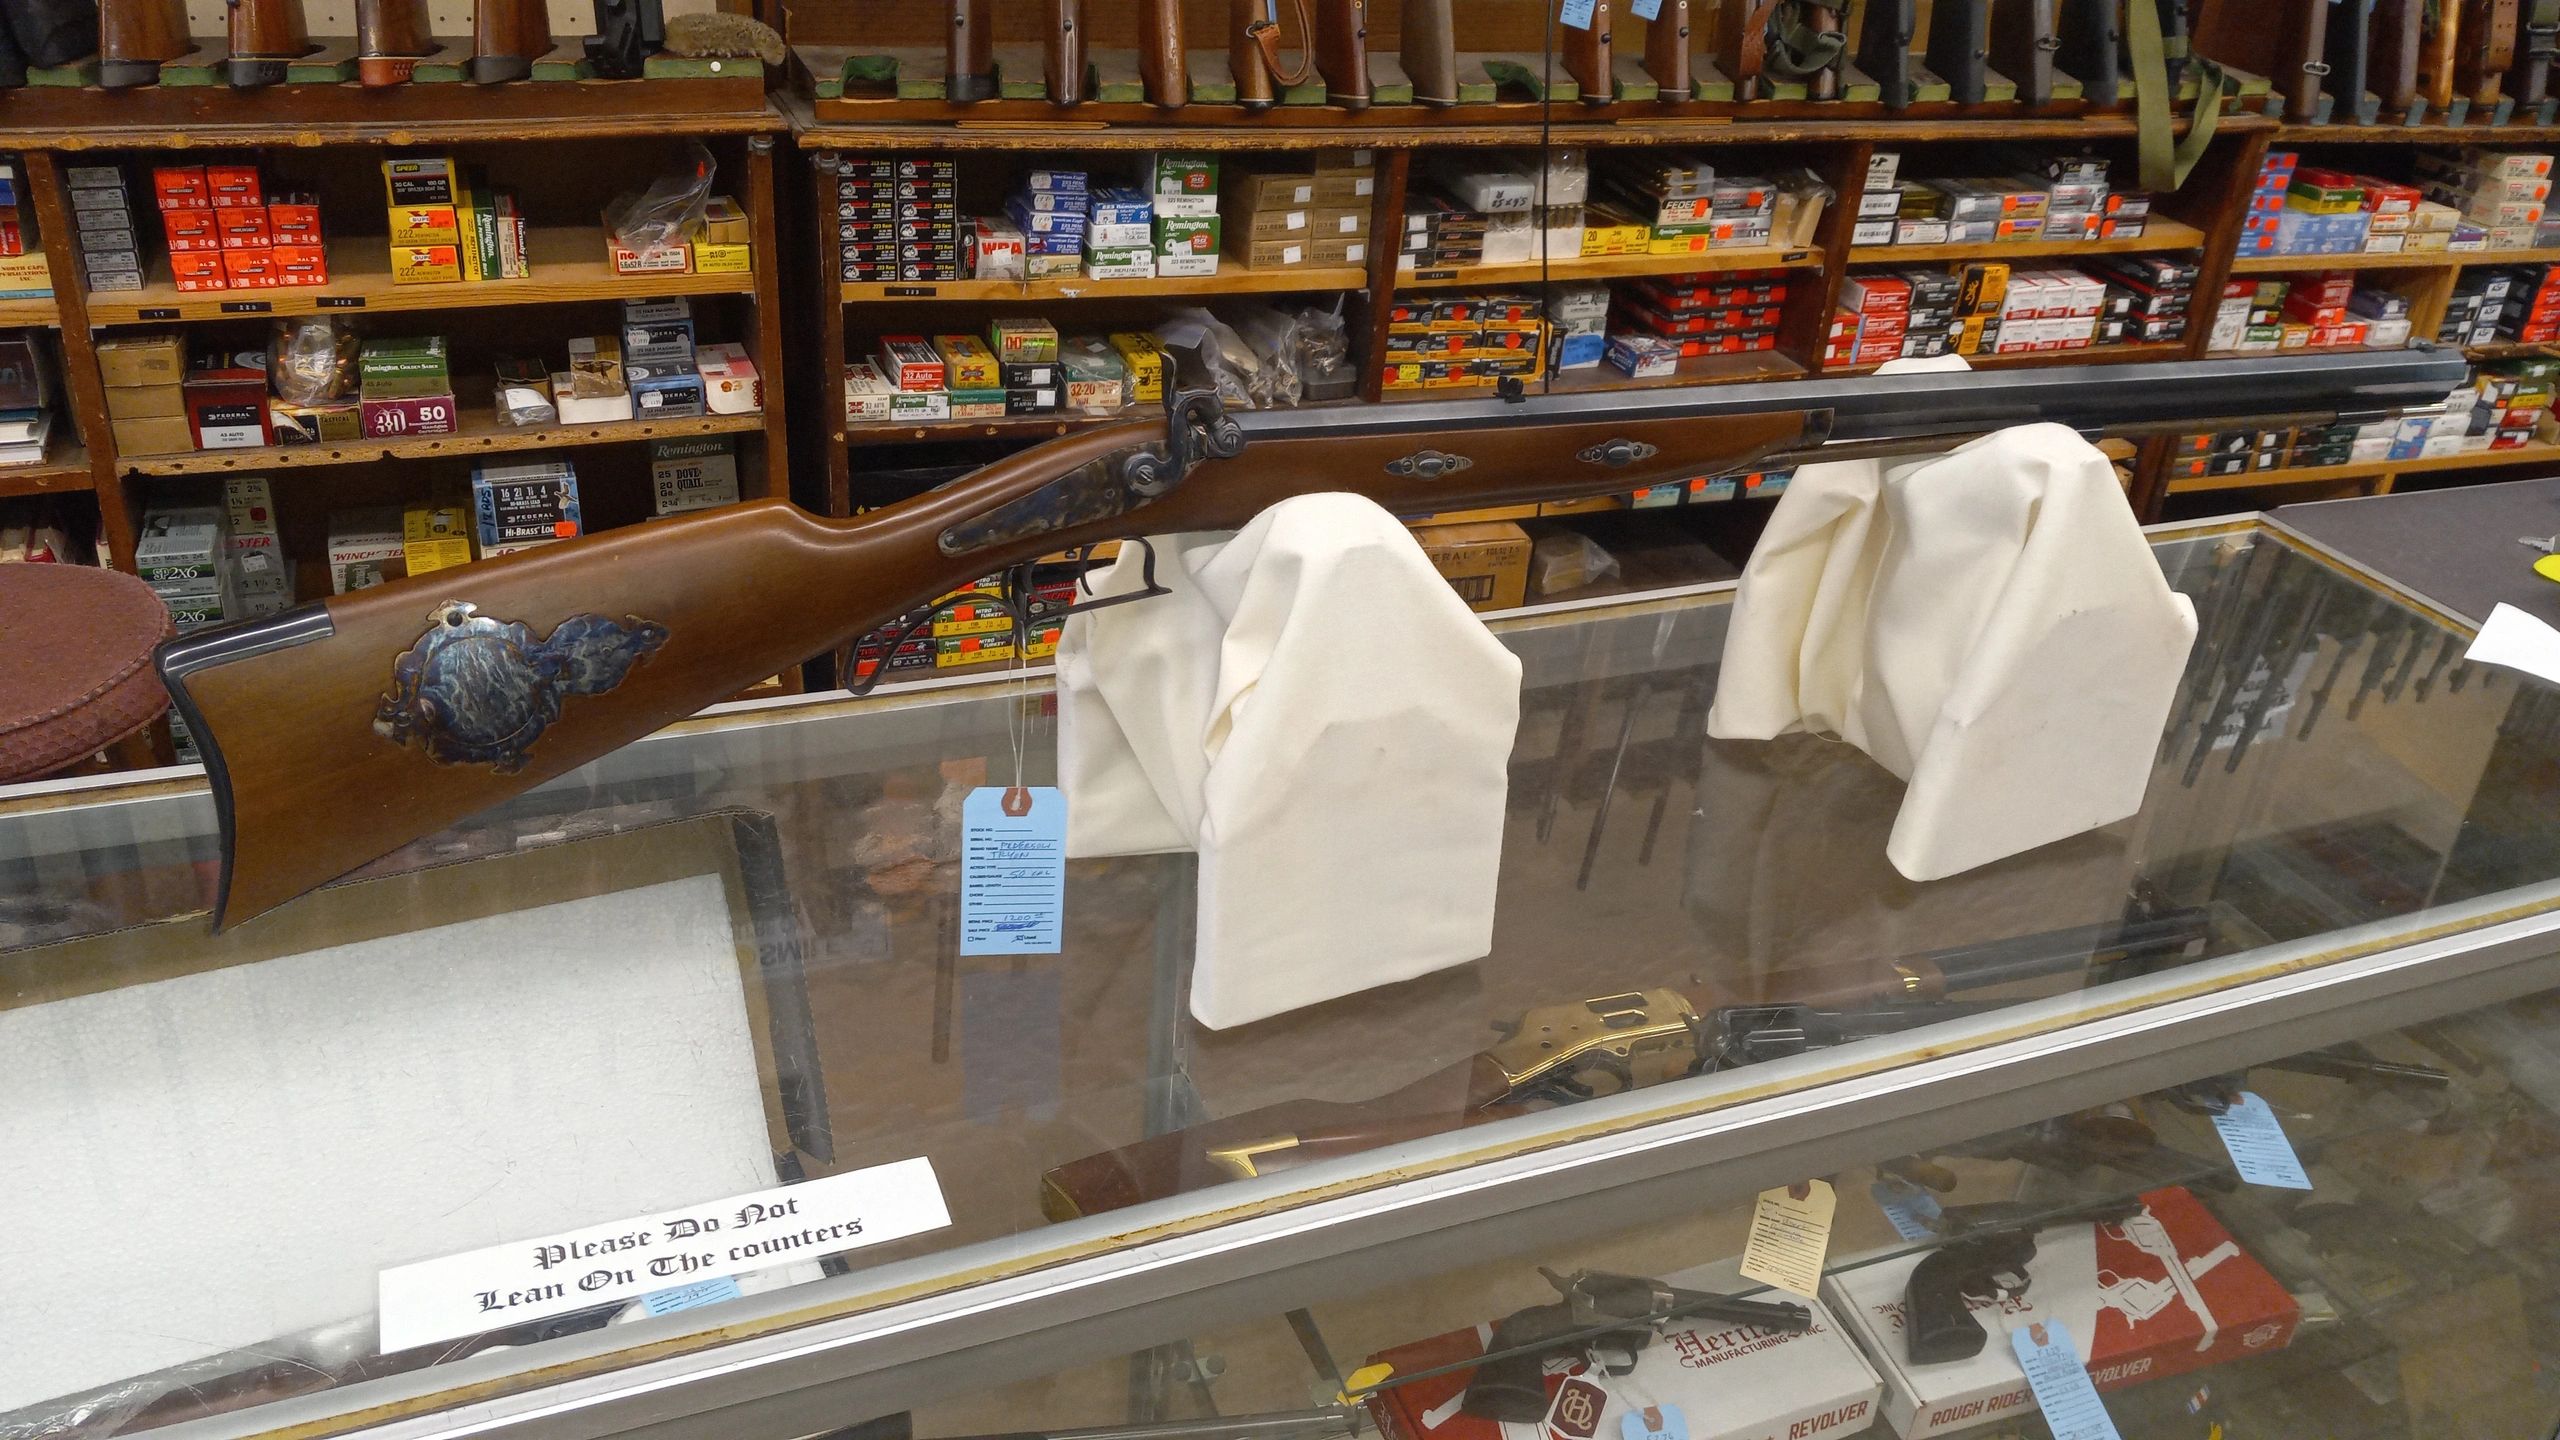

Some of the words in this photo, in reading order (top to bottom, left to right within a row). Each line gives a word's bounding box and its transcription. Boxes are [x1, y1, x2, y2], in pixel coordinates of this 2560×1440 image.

[1665, 200, 1697, 210] FEDER
[1139, 211, 1149, 219] 20
[397, 230, 414, 239] 222
[1588, 230, 1598, 241] 20
[1635, 229, 1646, 240] 20
[619, 250, 639, 260] no.
[399, 268, 416, 277] 222
[905, 372, 915, 380] 32
[419, 405, 446, 422] 50
[657, 442, 723, 458] Remington
[658, 471, 672, 479] 25
[676, 467, 700, 480] DOVE
[500, 488, 510, 498] 16
[540, 485, 546, 495] 4
[660, 482, 673, 490] 20
[677, 479, 704, 492] QUAIL
[541, 525, 555, 534] LOA
[1432, 551, 1470, 563] ERAL
[170, 608, 209, 624] P2x6
[533, 1230, 653, 1270] Please
[663, 1217, 721, 1243] Do
[732, 1197, 800, 1229] Not
[473, 1282, 566, 1313] Lean
[578, 1267, 636, 1291] On
[646, 1252, 716, 1277] The
[728, 1217, 864, 1262] counters
[1693, 1333, 1790, 1370] MANUFACTURING
[2087, 1357, 2153, 1385] VOLVER
[1788, 1400, 1870, 1440] REVOLVER
[1929, 1400, 1985, 1428] ROUGH
